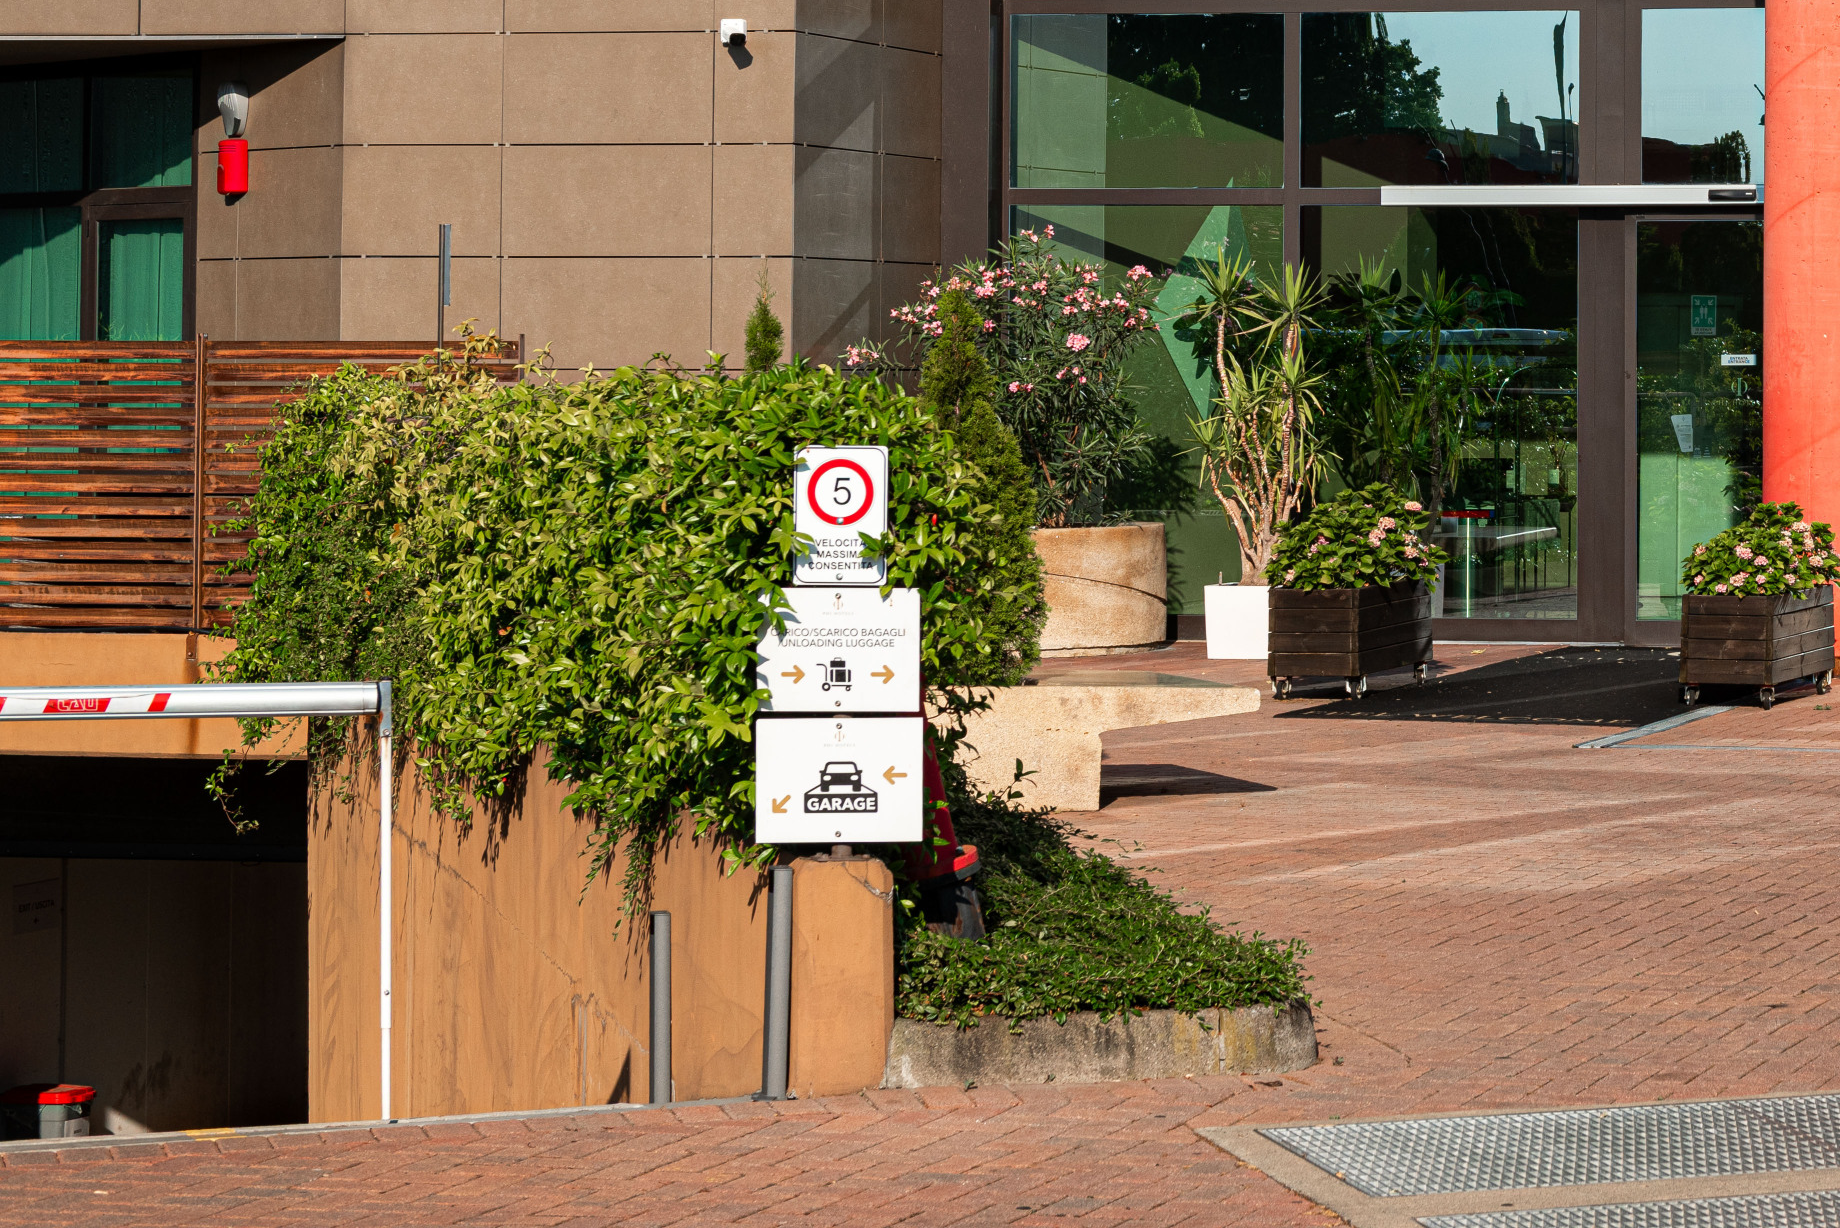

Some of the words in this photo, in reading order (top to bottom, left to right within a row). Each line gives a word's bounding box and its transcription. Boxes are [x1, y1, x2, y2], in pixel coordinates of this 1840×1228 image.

[833, 477, 852, 505] 5
[817, 550, 858, 559] MASSIM
[808, 561, 874, 570] CONSENTITA
[861, 628, 906, 637] BAGAGLI
[846, 638, 895, 647] LUGGAGE
[806, 797, 876, 811] GARAGE
